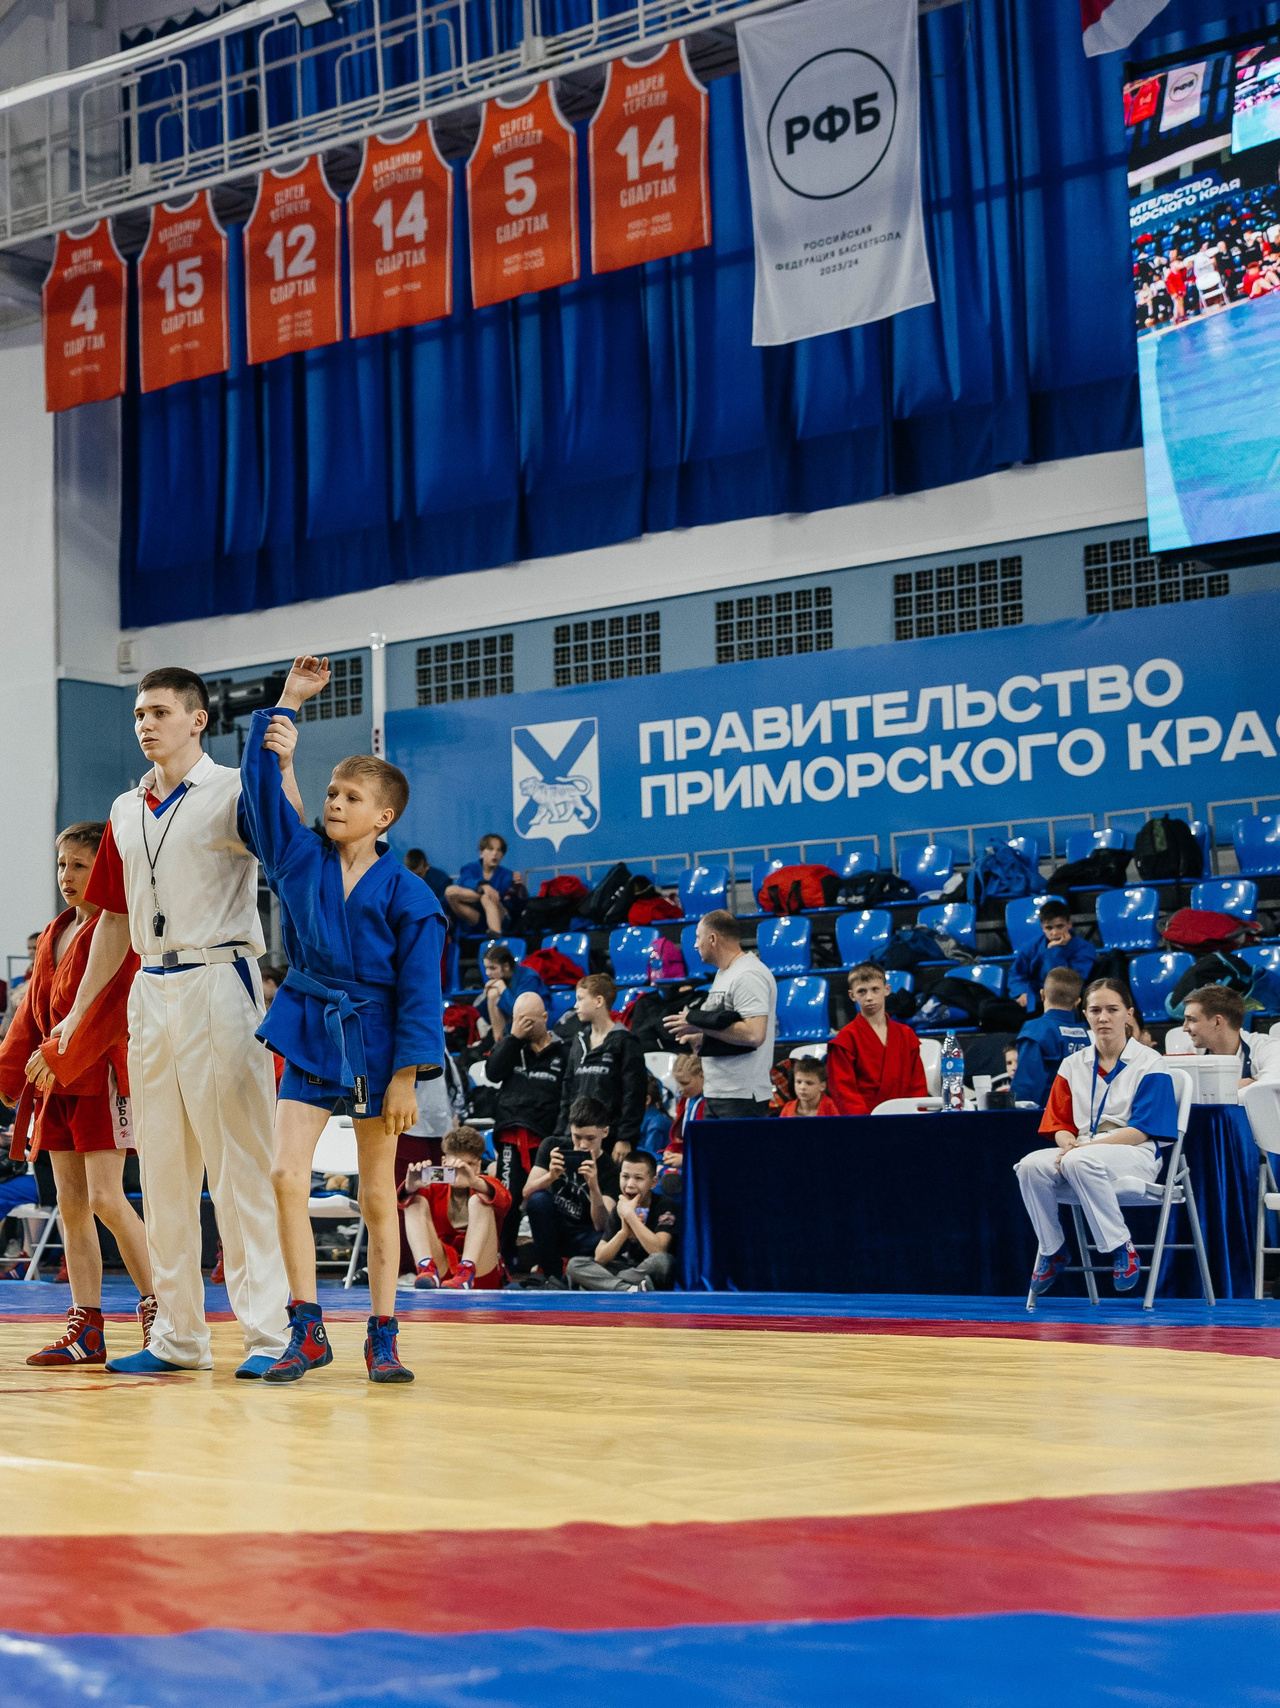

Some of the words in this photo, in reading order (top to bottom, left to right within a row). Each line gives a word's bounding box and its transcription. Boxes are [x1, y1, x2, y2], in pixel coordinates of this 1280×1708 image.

[784, 92, 881, 156] РФБ
[615, 115, 679, 181] 14
[504, 158, 537, 214] 5
[620, 176, 677, 208] СПАРТАК
[1199, 178, 1240, 201] КРАЯ
[372, 190, 428, 251] 14
[495, 213, 549, 244] СПАРТАК
[266, 224, 316, 281] 12
[775, 250, 836, 271] ФЕДЕРАЦИЯ
[838, 231, 901, 258] БАСКЕТБОЛА
[803, 225, 873, 251] РОССИЙСКАЯ
[375, 248, 426, 276] СПАРТАК
[820, 258, 859, 276] 2023/24
[157, 256, 204, 312] 15
[270, 277, 317, 305] СПАРТАК
[71, 285, 97, 331] 4
[161, 308, 204, 335] СПАРТАК
[64, 334, 105, 357] СПАРТАК
[639, 657, 1183, 766] ПРАВИТЕЛЬСТВО
[640, 726, 1107, 820] ПРИМОРСКОГО
[1127, 710, 1280, 771] КРА
[575, 1066, 609, 1075] AMBO
[116, 1093, 128, 1127] МБО
